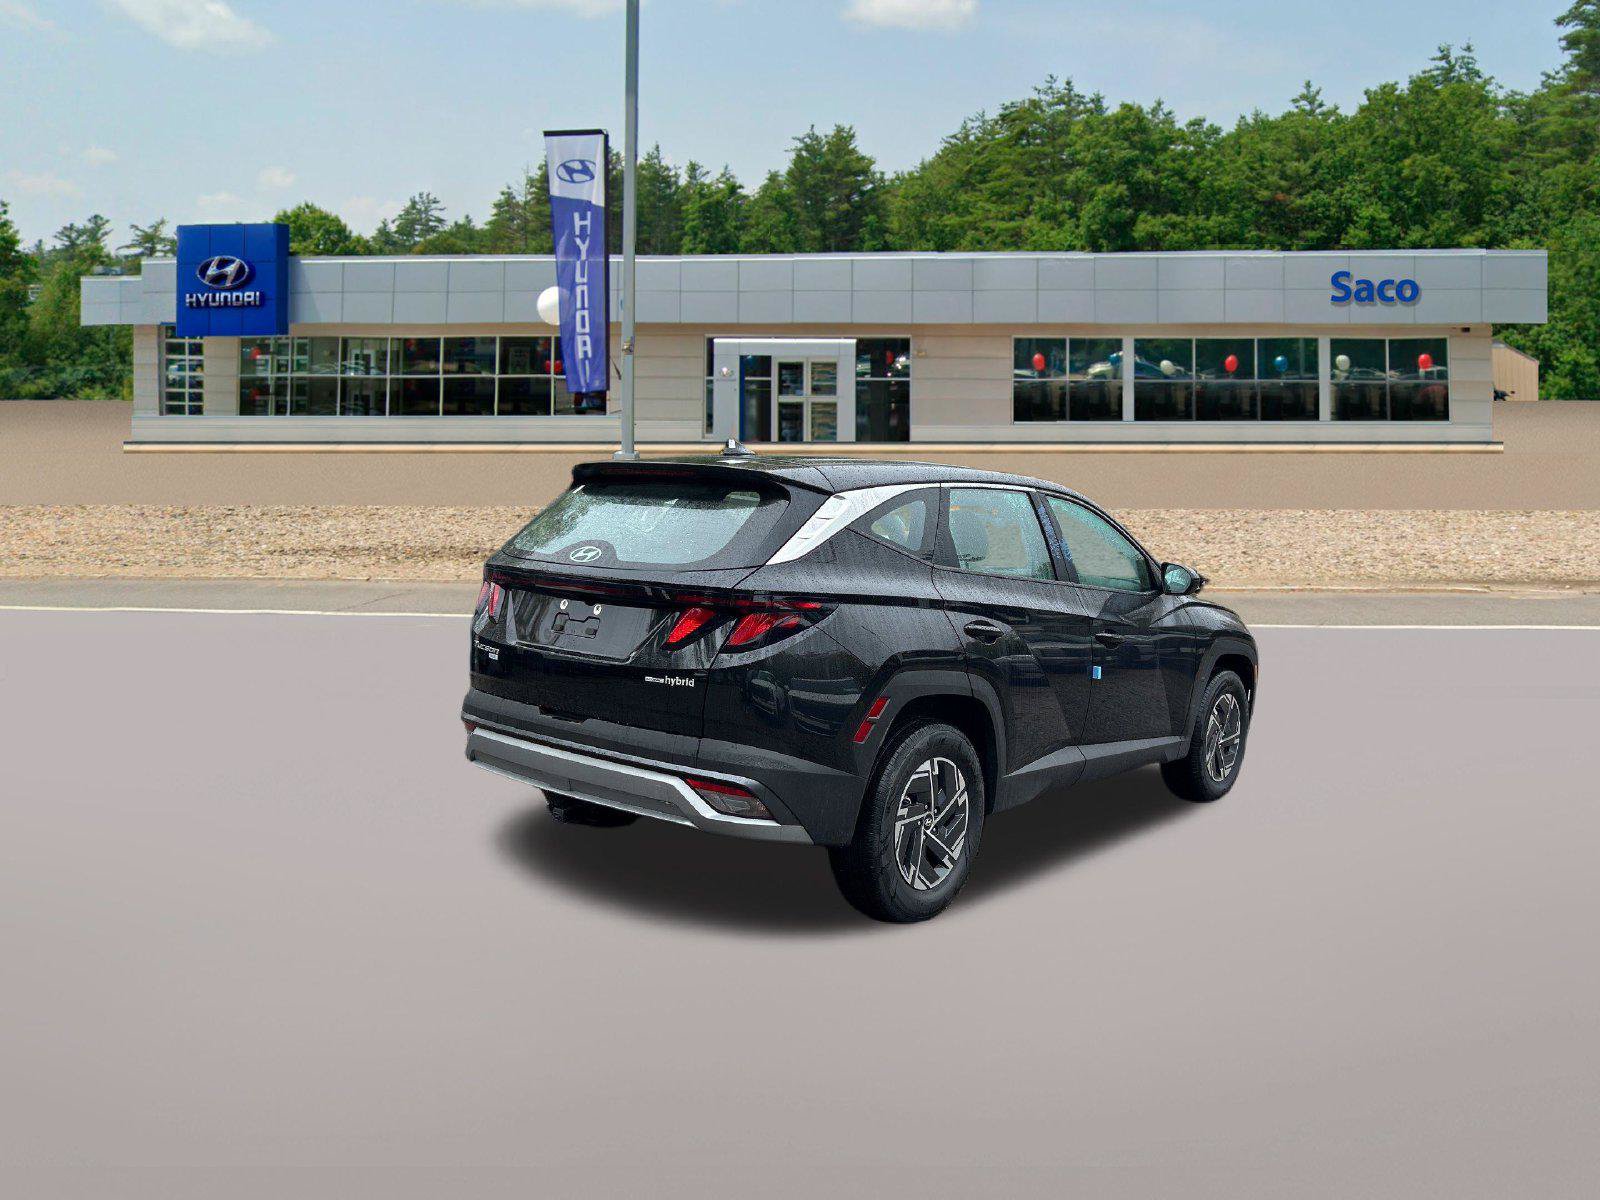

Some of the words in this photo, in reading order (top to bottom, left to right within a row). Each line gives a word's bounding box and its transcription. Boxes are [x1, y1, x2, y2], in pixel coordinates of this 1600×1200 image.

[573, 210, 592, 386] HYUNDAI
[1330, 270, 1420, 303] Saco
[185, 291, 260, 307] HYUNDAI
[664, 675, 695, 688] hybrid
